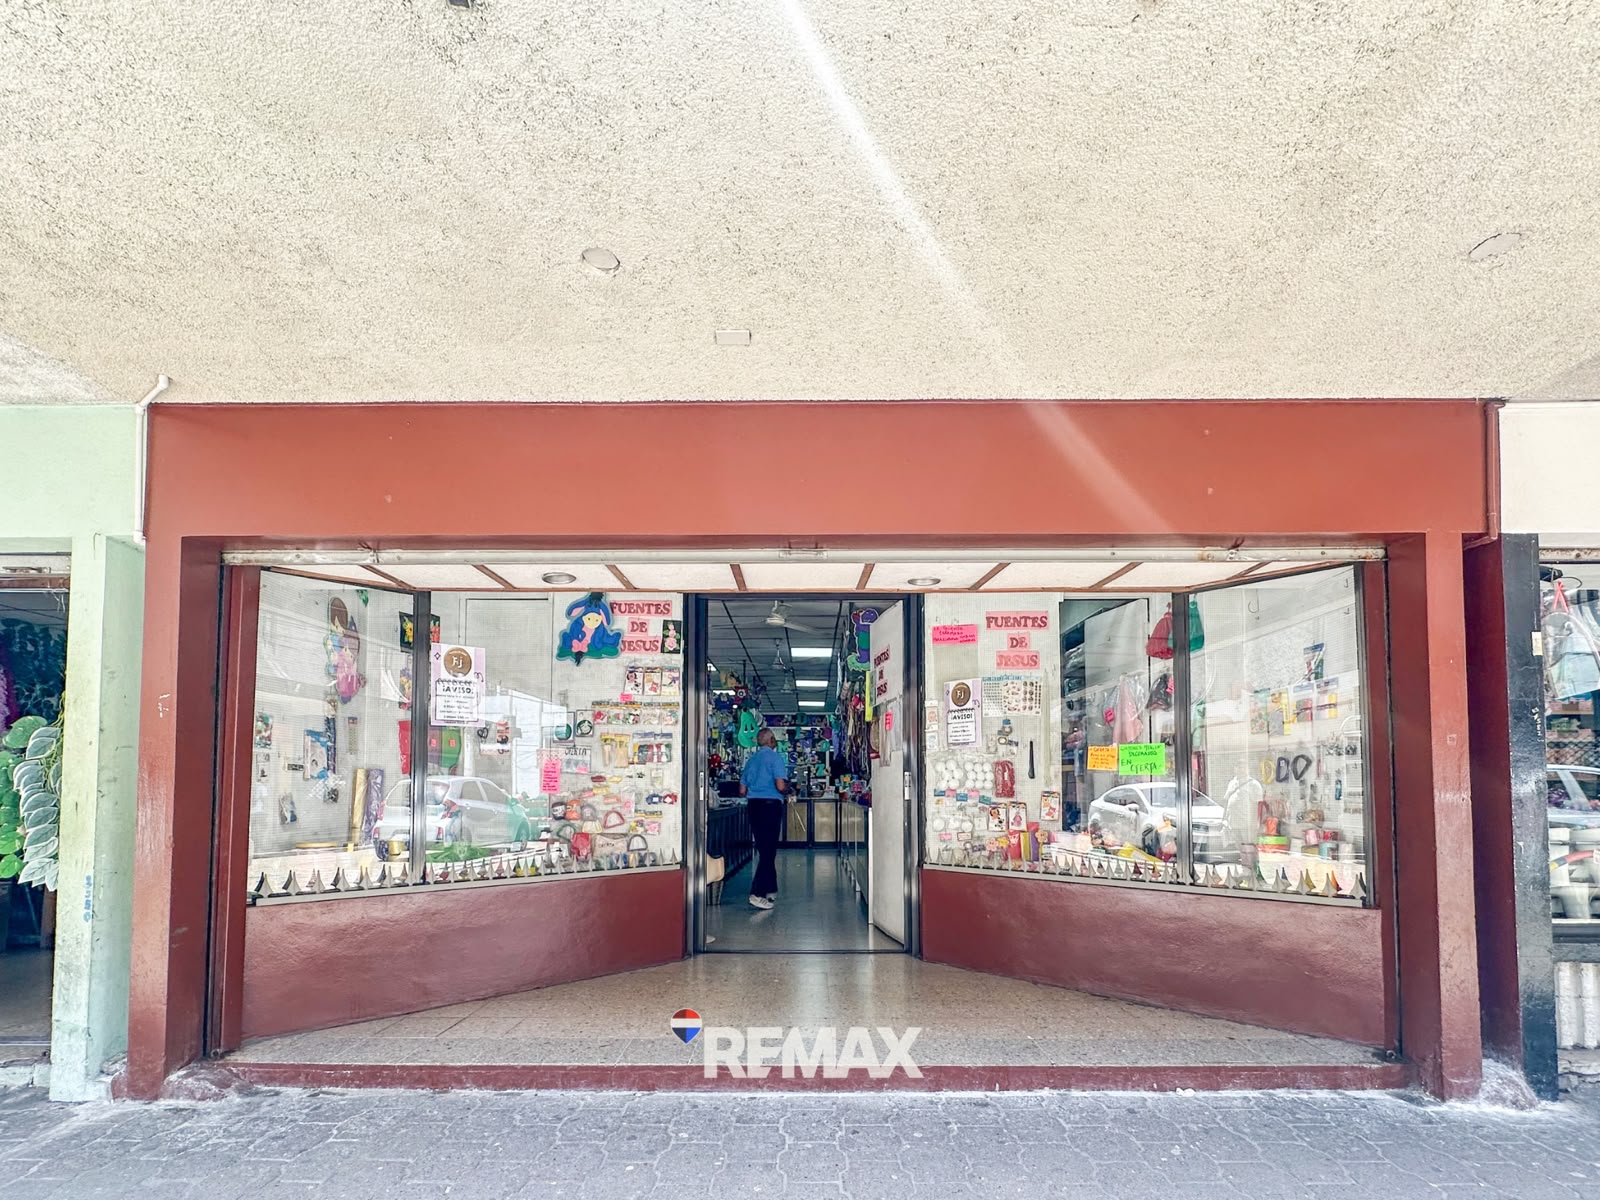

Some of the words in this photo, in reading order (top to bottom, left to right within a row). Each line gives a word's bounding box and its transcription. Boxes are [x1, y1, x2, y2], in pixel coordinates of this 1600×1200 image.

[610, 601, 671, 615] FUENTES
[630, 621, 648, 633] DE
[986, 615, 1048, 629] FUENTES
[620, 639, 659, 652] JESUS
[1009, 637, 1028, 649] DE
[997, 654, 1039, 667] JESUS
[1120, 758, 1132, 767] EN
